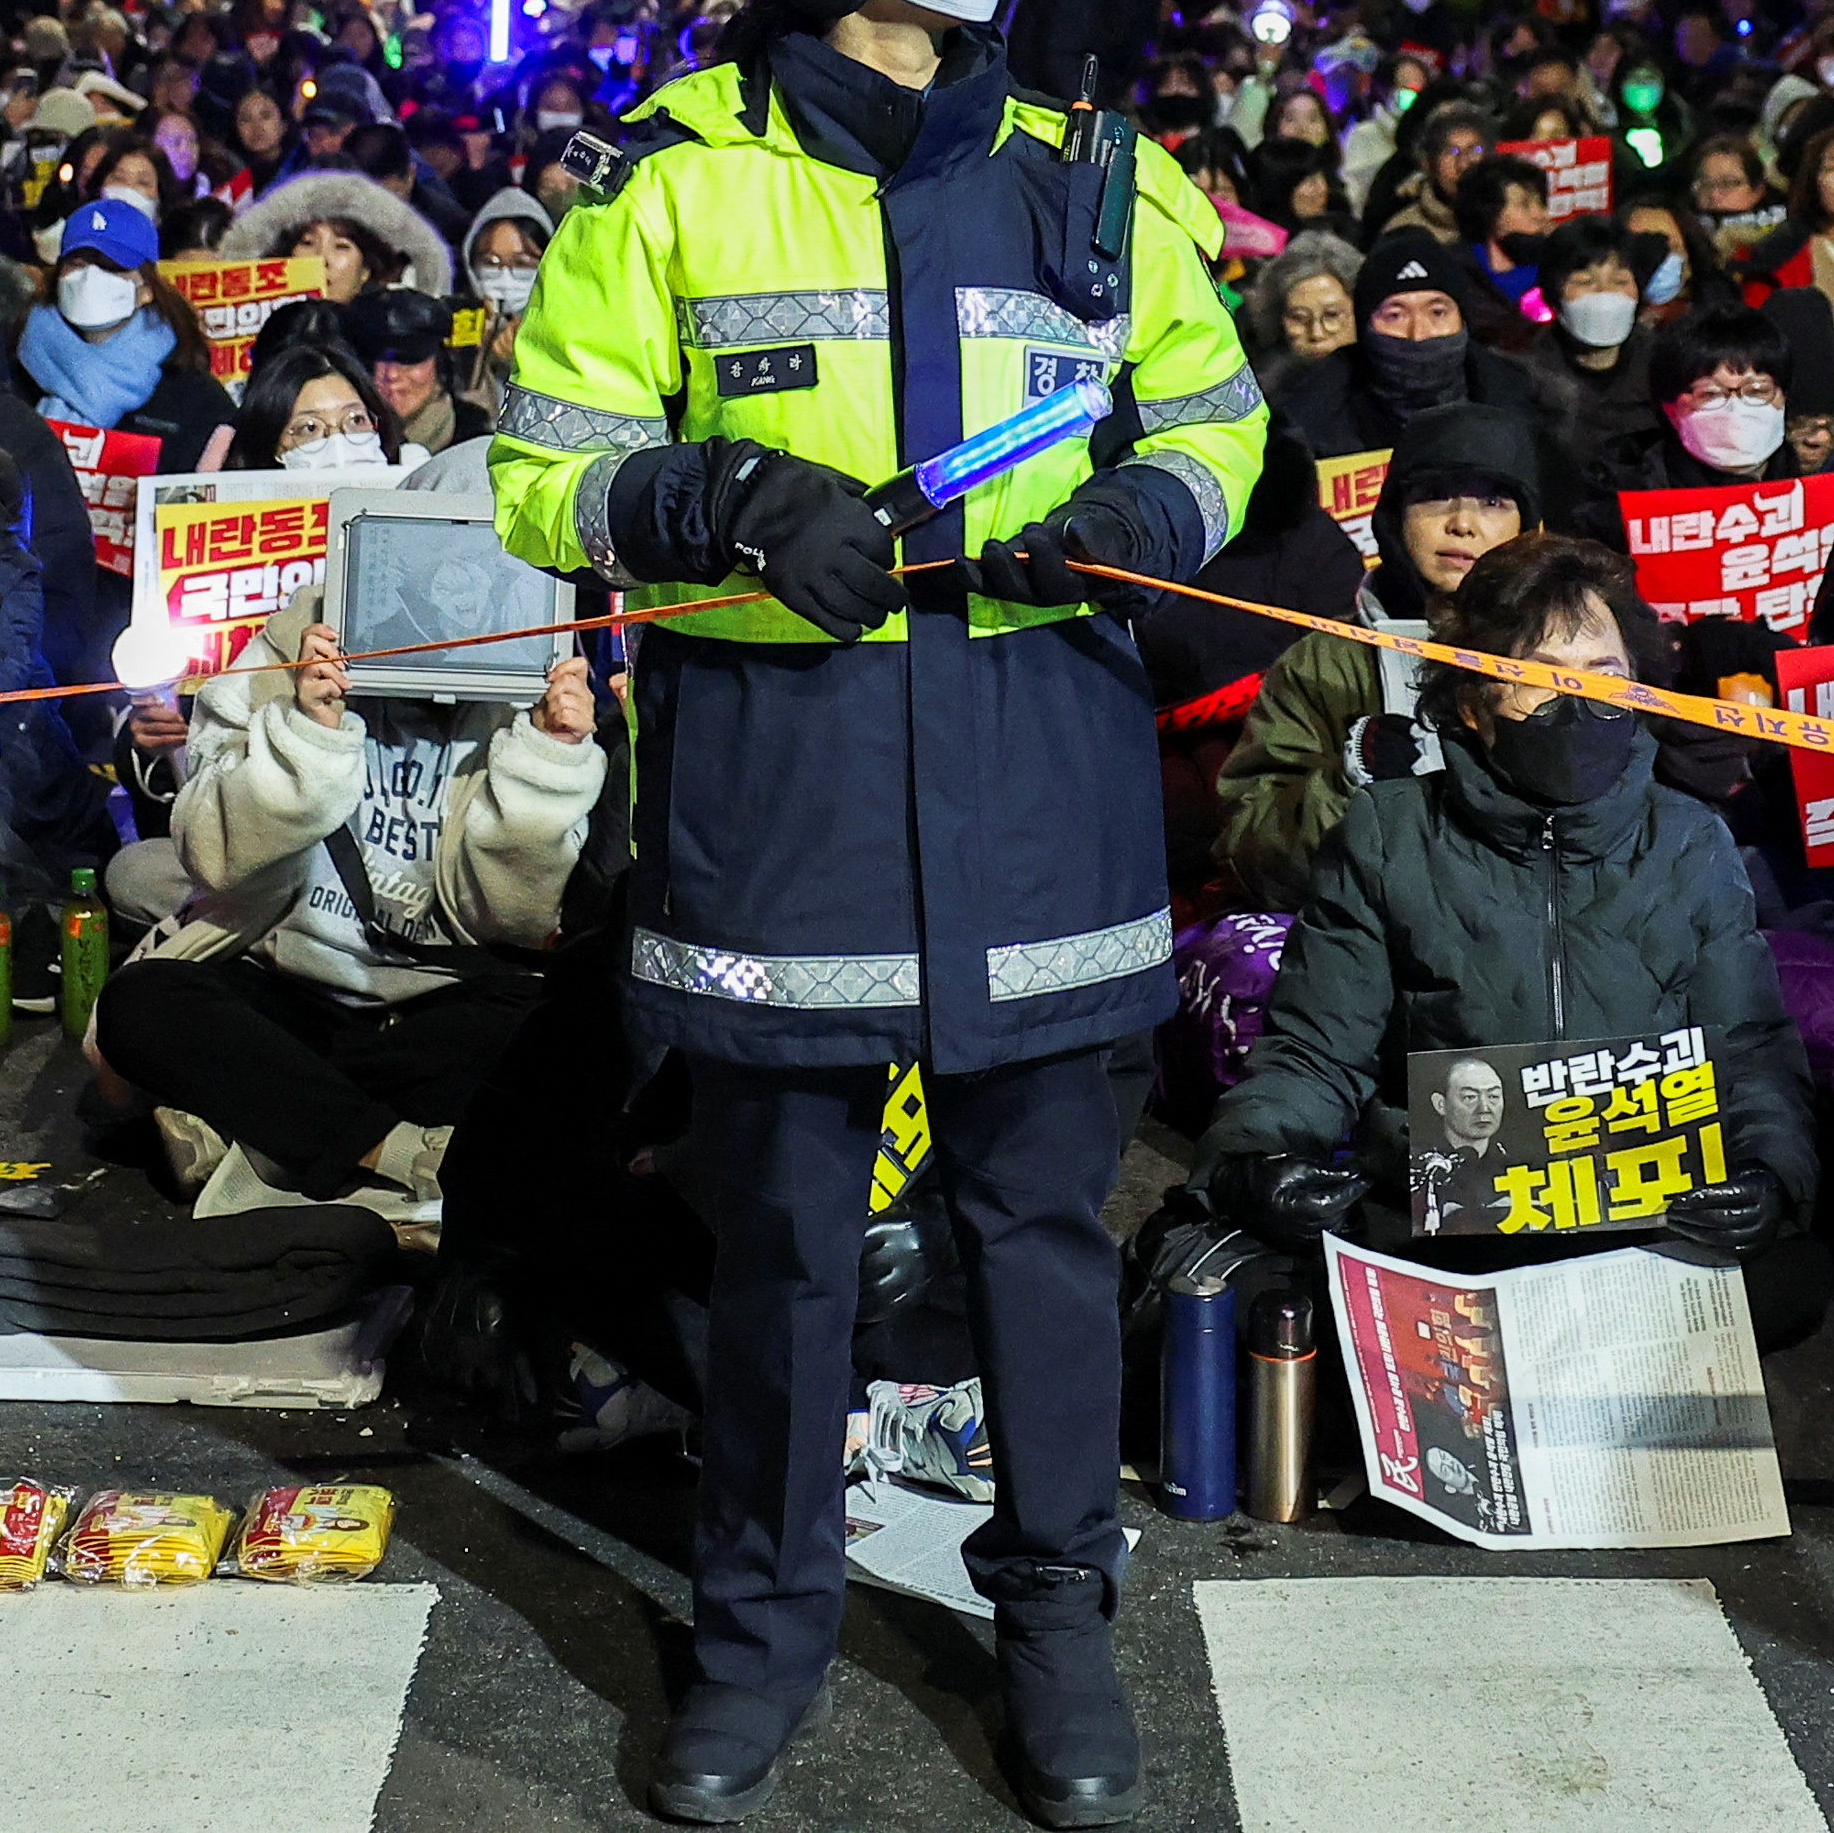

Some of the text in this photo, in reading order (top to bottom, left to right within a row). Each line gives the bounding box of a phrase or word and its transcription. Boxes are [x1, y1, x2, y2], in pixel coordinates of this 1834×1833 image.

[1628, 478, 1805, 555] 내란수괴
[365, 807, 441, 862] BEST
[1519, 1026, 1707, 1110] 반란수괴
[1543, 1060, 1719, 1155] 윤석열
[1381, 1453, 1418, 1493] 民
